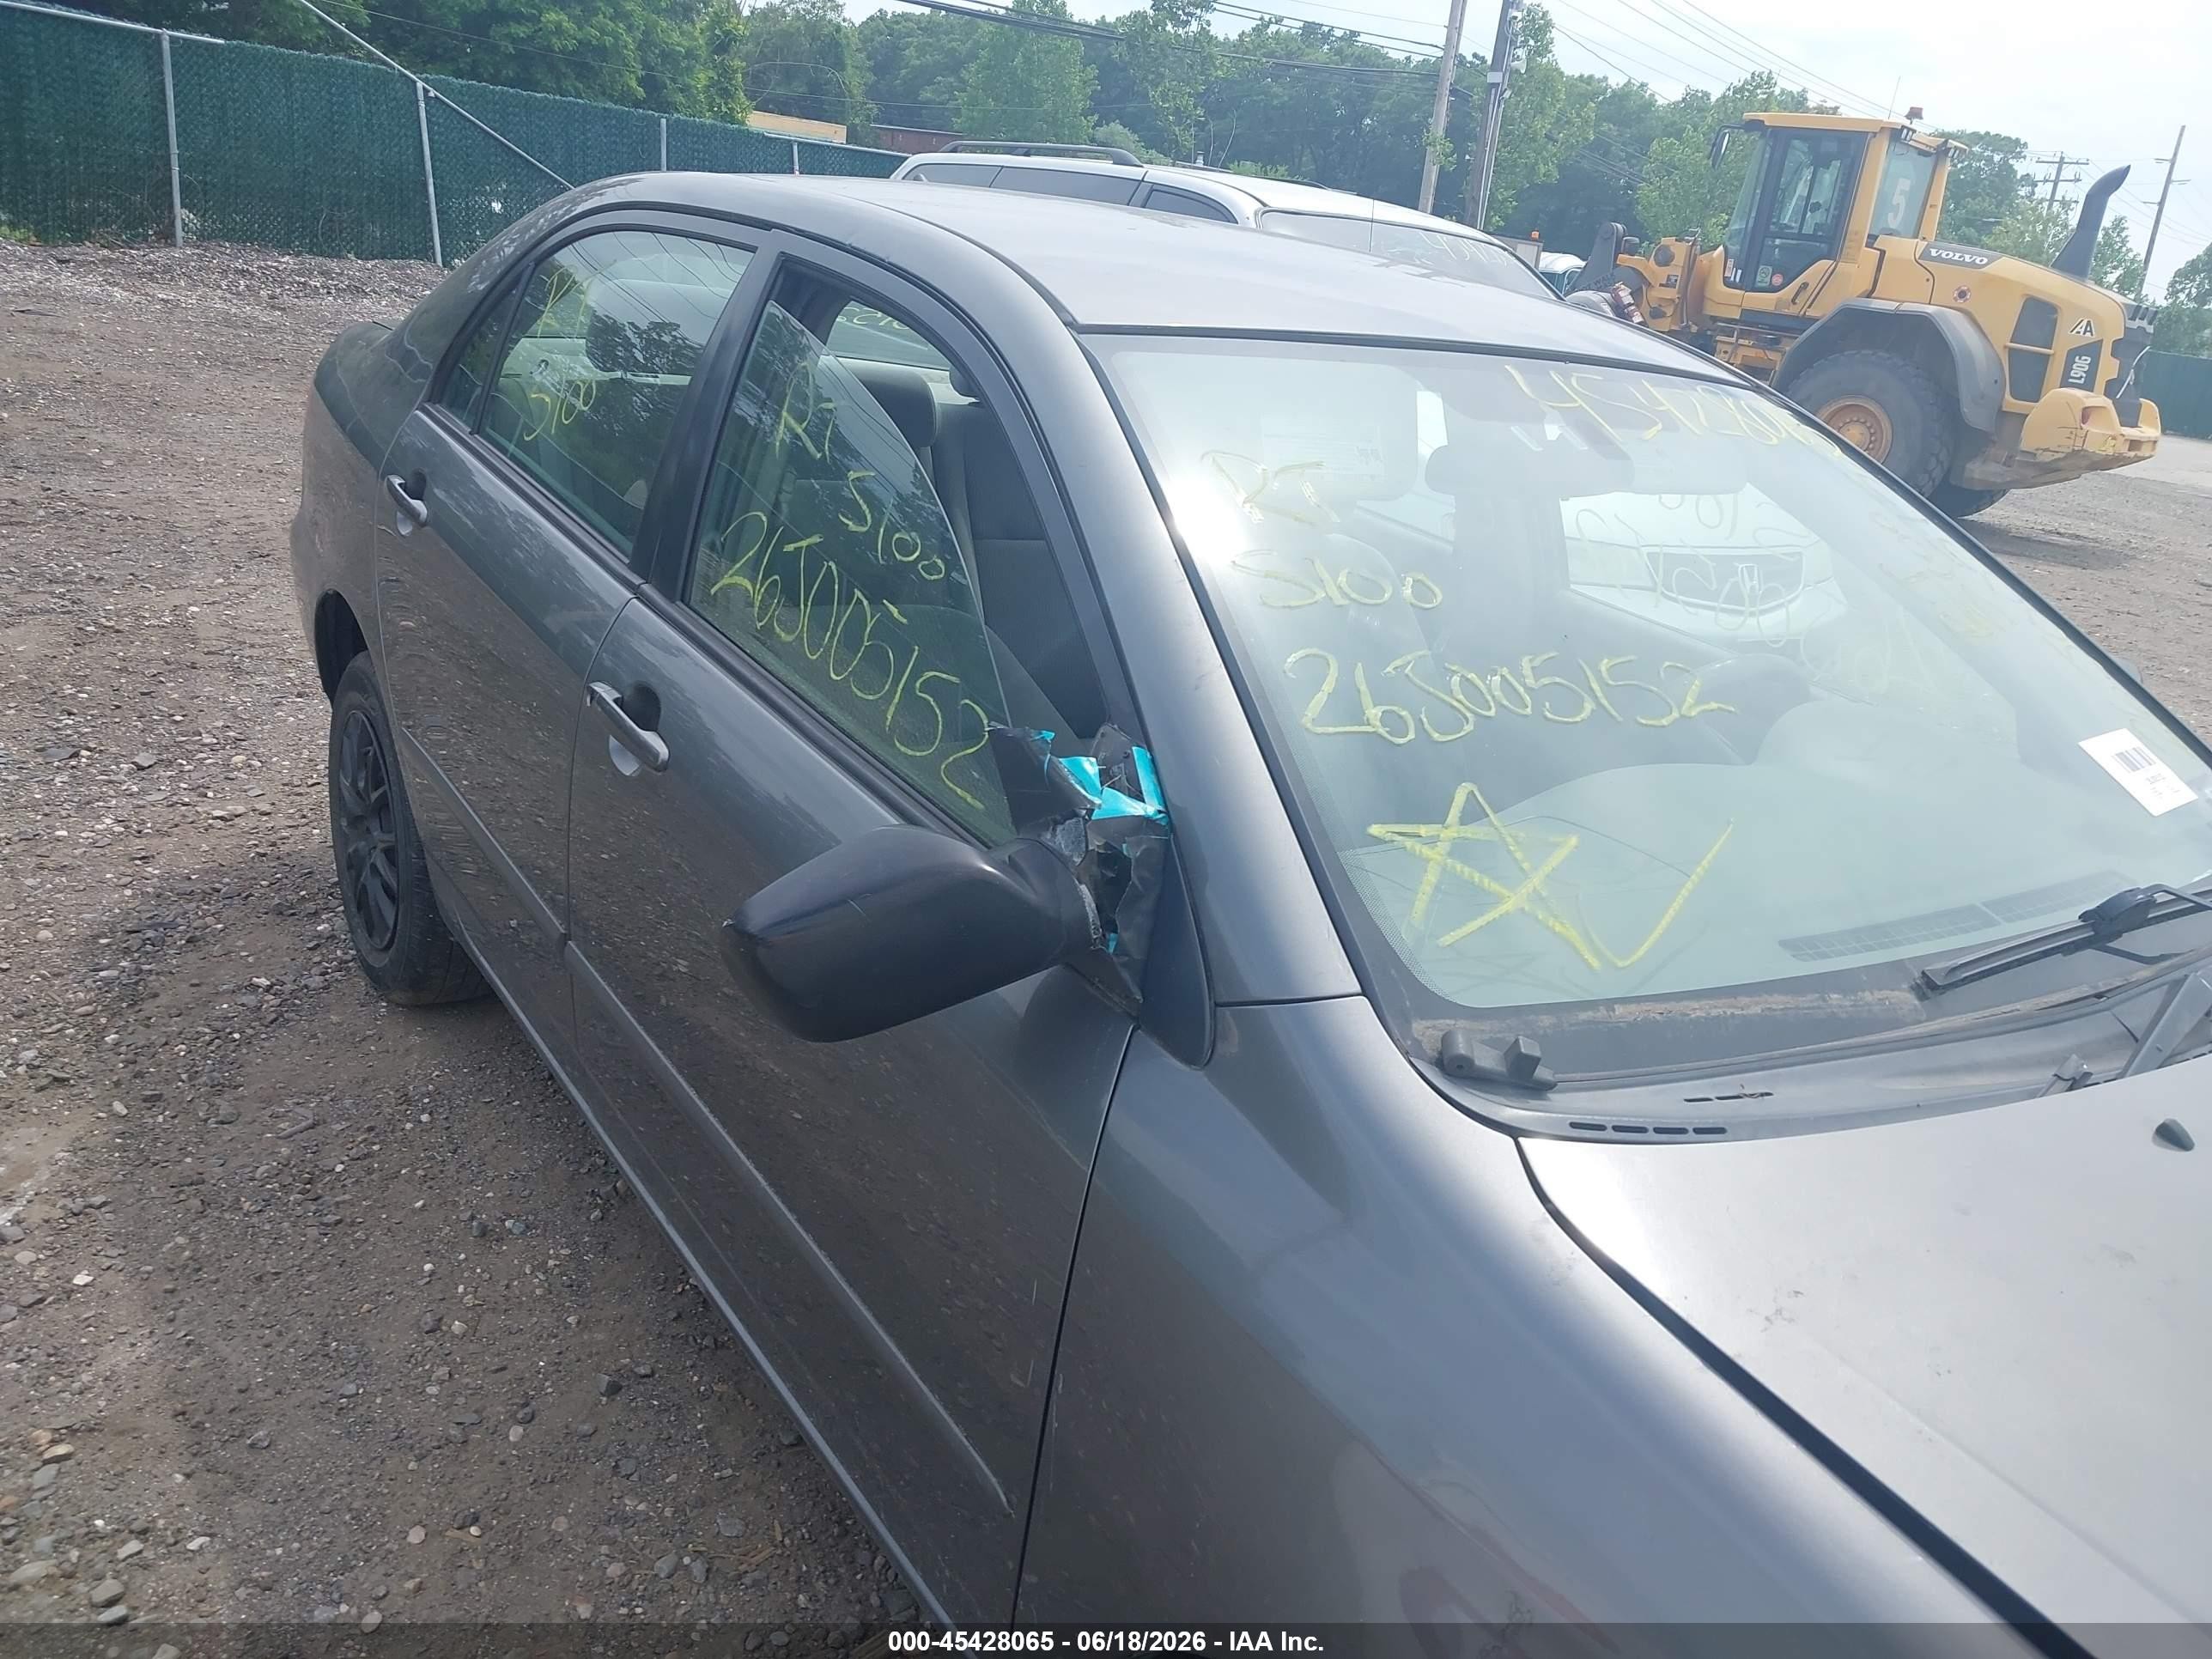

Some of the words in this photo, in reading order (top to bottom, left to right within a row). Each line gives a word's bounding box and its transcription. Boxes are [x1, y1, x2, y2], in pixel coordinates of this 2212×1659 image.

[1887, 177, 1911, 230] 5
[1929, 247, 1989, 265] VOLVO
[2067, 356, 2092, 385] L90G
